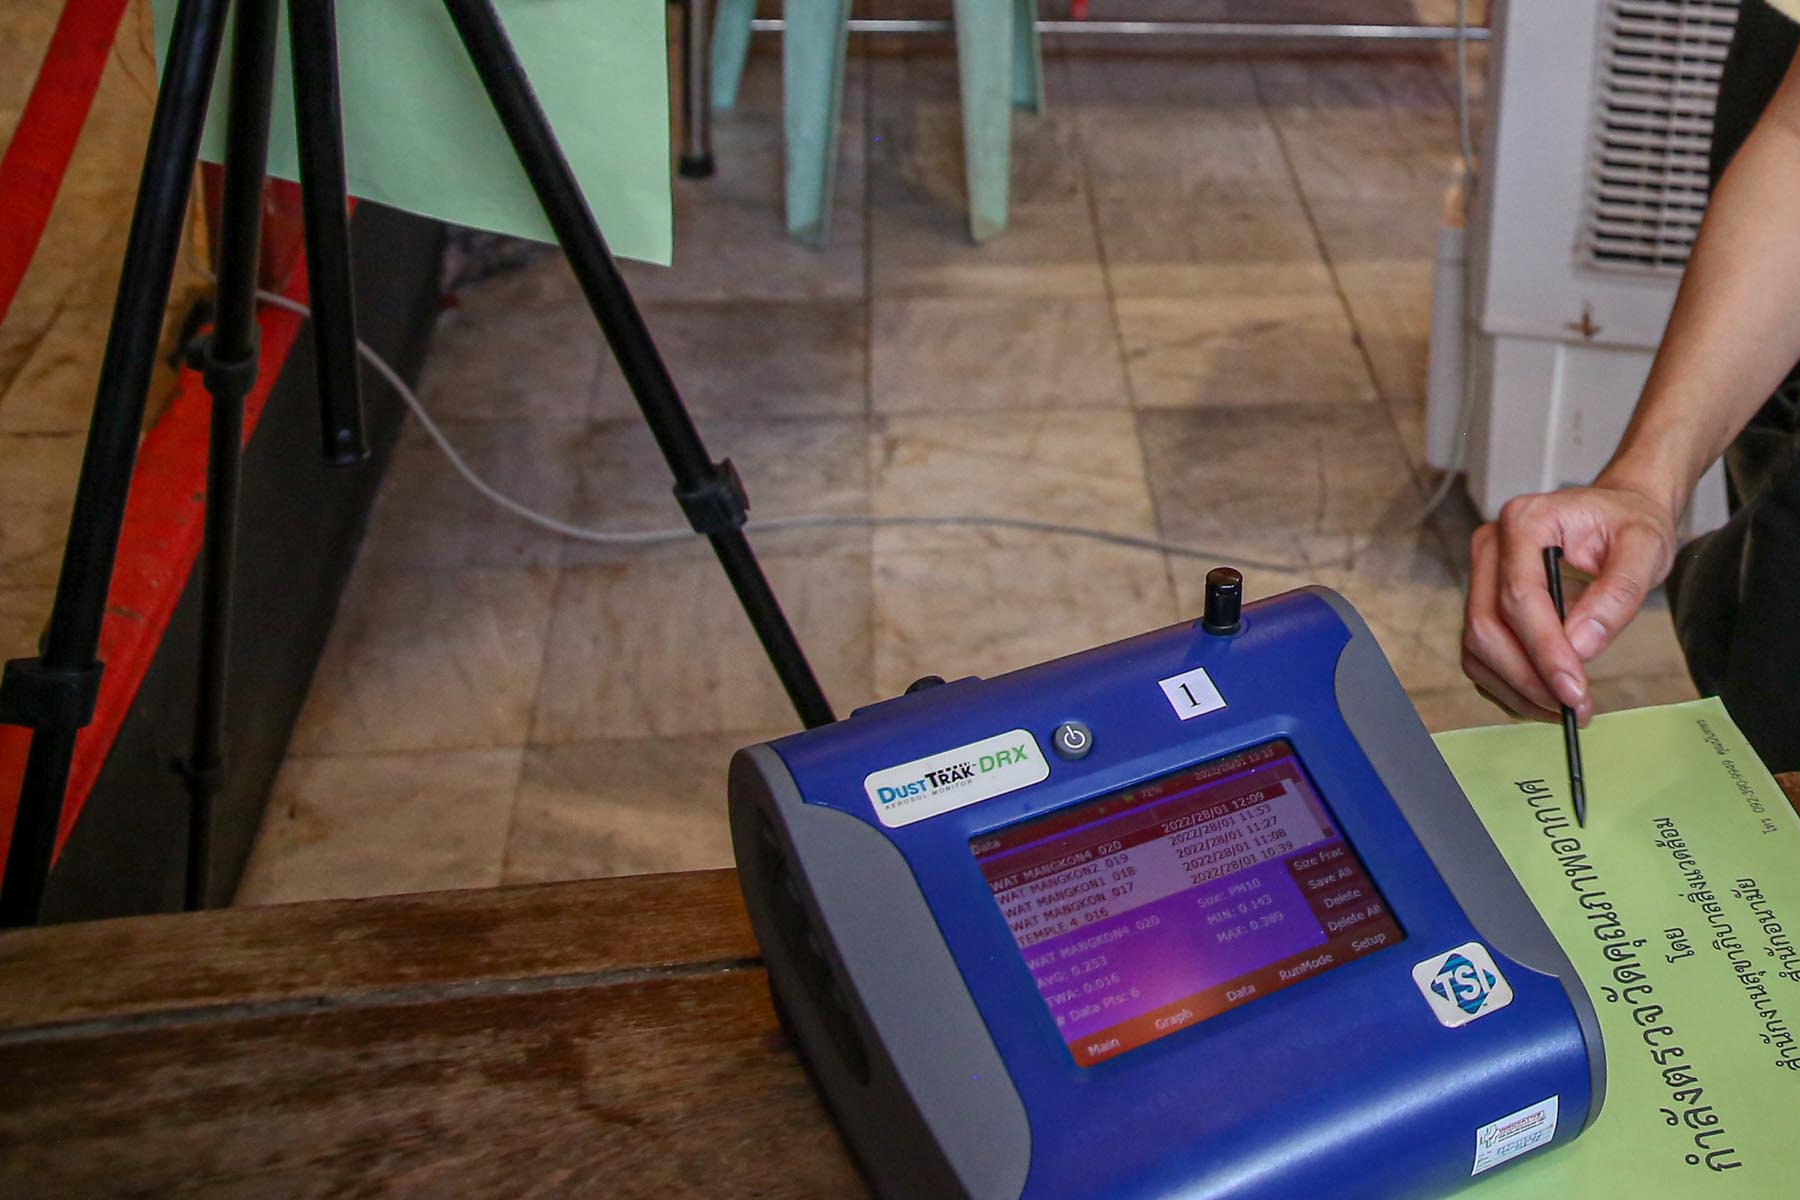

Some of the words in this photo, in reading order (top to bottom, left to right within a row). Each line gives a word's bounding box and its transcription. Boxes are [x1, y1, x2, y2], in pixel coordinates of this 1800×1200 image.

[1179, 682, 1201, 708] 1
[978, 745, 1029, 773] DRX
[885, 793, 928, 811] AEROSOL
[931, 779, 973, 796] MONITOR
[990, 876, 1018, 892] WAT
[1022, 850, 1093, 881] MANGKON4
[1098, 840, 1122, 855] 020
[1161, 804, 1230, 832] 2022/28/01
[1231, 790, 1265, 810] 12:09
[998, 888, 1024, 905] WAT
[1104, 854, 1129, 869] 019
[1169, 816, 1236, 846] 2022/28/01
[1240, 803, 1273, 821] 11:53
[1005, 902, 1033, 919] WAT
[1177, 829, 1244, 858] 2022/28/01
[1248, 815, 1279, 834] 11:27
[1293, 854, 1318, 871] Size
[1308, 873, 1337, 889] Save
[1338, 866, 1354, 880] All
[1011, 916, 1039, 933] WAT
[1043, 892, 1106, 920] MANGKON
[1111, 882, 1135, 897] 017
[1182, 843, 1250, 872] 2022/28/01
[1254, 828, 1287, 847] 11:08
[1017, 923, 1065, 948] TEMPLE
[1191, 856, 1258, 885] 2022/28/01
[1262, 841, 1294, 860] 10:39
[1228, 878, 1262, 898] PM10
[1323, 887, 1362, 909] Delete
[1328, 911, 1365, 931] Delete
[1366, 903, 1381, 919] All
[1663, 926, 1696, 964] โดย
[1027, 952, 1055, 971] WAT
[1514, 778, 1744, 1173] กำลังตรวจวัดคุณภาพอากาศ
[1087, 1036, 1121, 1057] Main
[1154, 1008, 1194, 1031] Graph
[1225, 983, 1256, 1002] Data
[1278, 953, 1335, 981] RunMode
[1351, 932, 1387, 951] Setup
[1434, 962, 1493, 1006] TSI
[1070, 1004, 1101, 1022] Data
